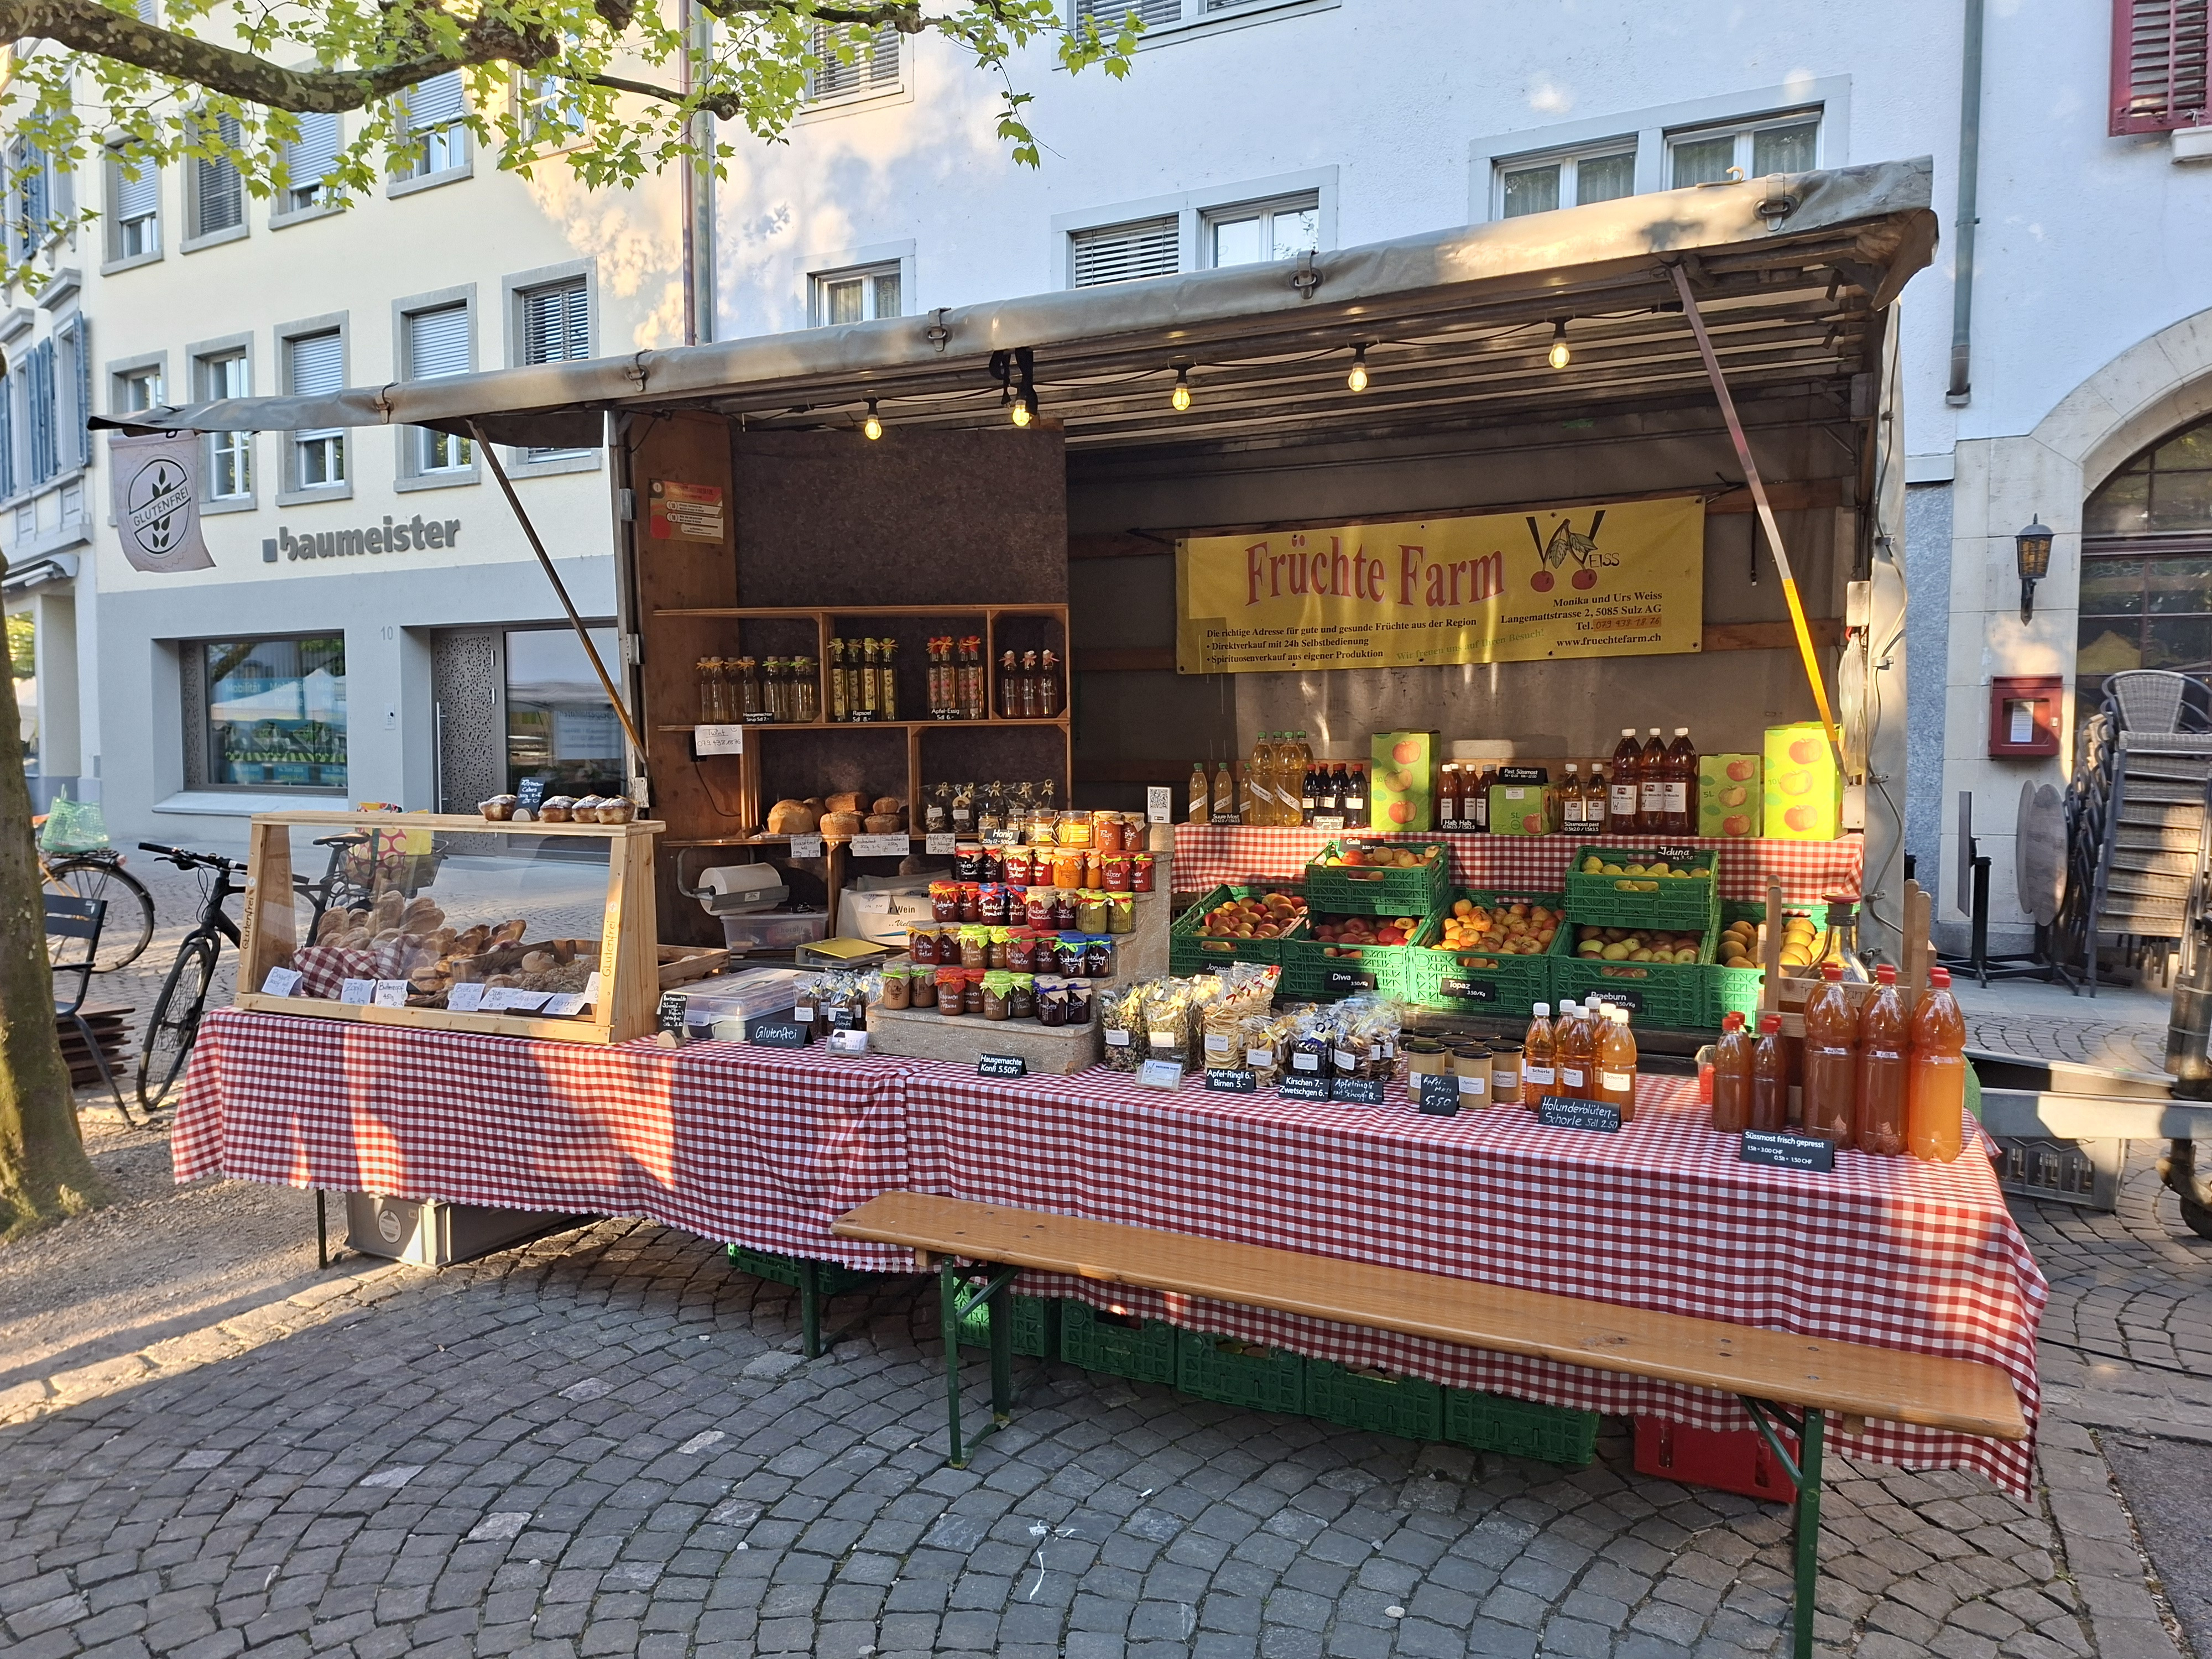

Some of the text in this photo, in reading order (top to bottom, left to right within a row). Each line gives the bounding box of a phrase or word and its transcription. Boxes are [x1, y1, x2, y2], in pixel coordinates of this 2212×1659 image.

[134, 486, 189, 526] GLUTENFREI
[279, 514, 460, 561] baumeister
[1245, 535, 1504, 607] Früchte Farm
[1553, 591, 1662, 607] Monika und Urs Weiss
[1501, 604, 1661, 624] Langemattstrasse 2, 5085 Sulz AG
[1207, 629, 1219, 638] Die
[1222, 628, 1250, 638] richtige
[1252, 627, 1284, 636] Adresse
[1286, 626, 1299, 635] für
[1301, 627, 1318, 636] gute
[1321, 625, 1337, 634] und
[1339, 623, 1373, 634] gesunde
[1375, 621, 1409, 631] Früchte
[1428, 619, 1443, 628] der
[1446, 617, 1477, 628] Region
[1575, 622, 1593, 630] Tel.
[380, 626, 393, 640] 10
[1212, 637, 1369, 650] Direktverkauf mit 24h Selbstbedienung
[1396, 629, 1545, 660] Wir freuen uns auf Ihren Besuch!
[1557, 633, 1661, 647] www.fruechtefarm.ch
[1212, 649, 1384, 664] Spirituosenverkauf aus eigener Produktion
[993, 829, 1013, 840] Honig
[1448, 980, 1470, 990] Topaz
[1591, 992, 1626, 1001] Braeburn
[755, 1026, 797, 1040] Glutenfrei
[980, 1055, 1022, 1066] Hausgemachte
[980, 1063, 1018, 1074] Konfi 5.50Fr
[1207, 1070, 1244, 1079] Apfel-Ringli
[1213, 1079, 1234, 1087] Birnen
[1286, 1077, 1312, 1087] Kirschen
[1335, 1079, 1374, 1090] Apfelringli
[1279, 1086, 1317, 1097] Zwetschgen
[1342, 1089, 1368, 1102] Schoggi
[1425, 1095, 1452, 1107] 5.50
[1542, 1097, 1617, 1119] Holunderblüten-
[1543, 1112, 1618, 1129] Schorle 5dl 2.50
[1745, 1131, 1824, 1149] Süssmost frisch gepresst
